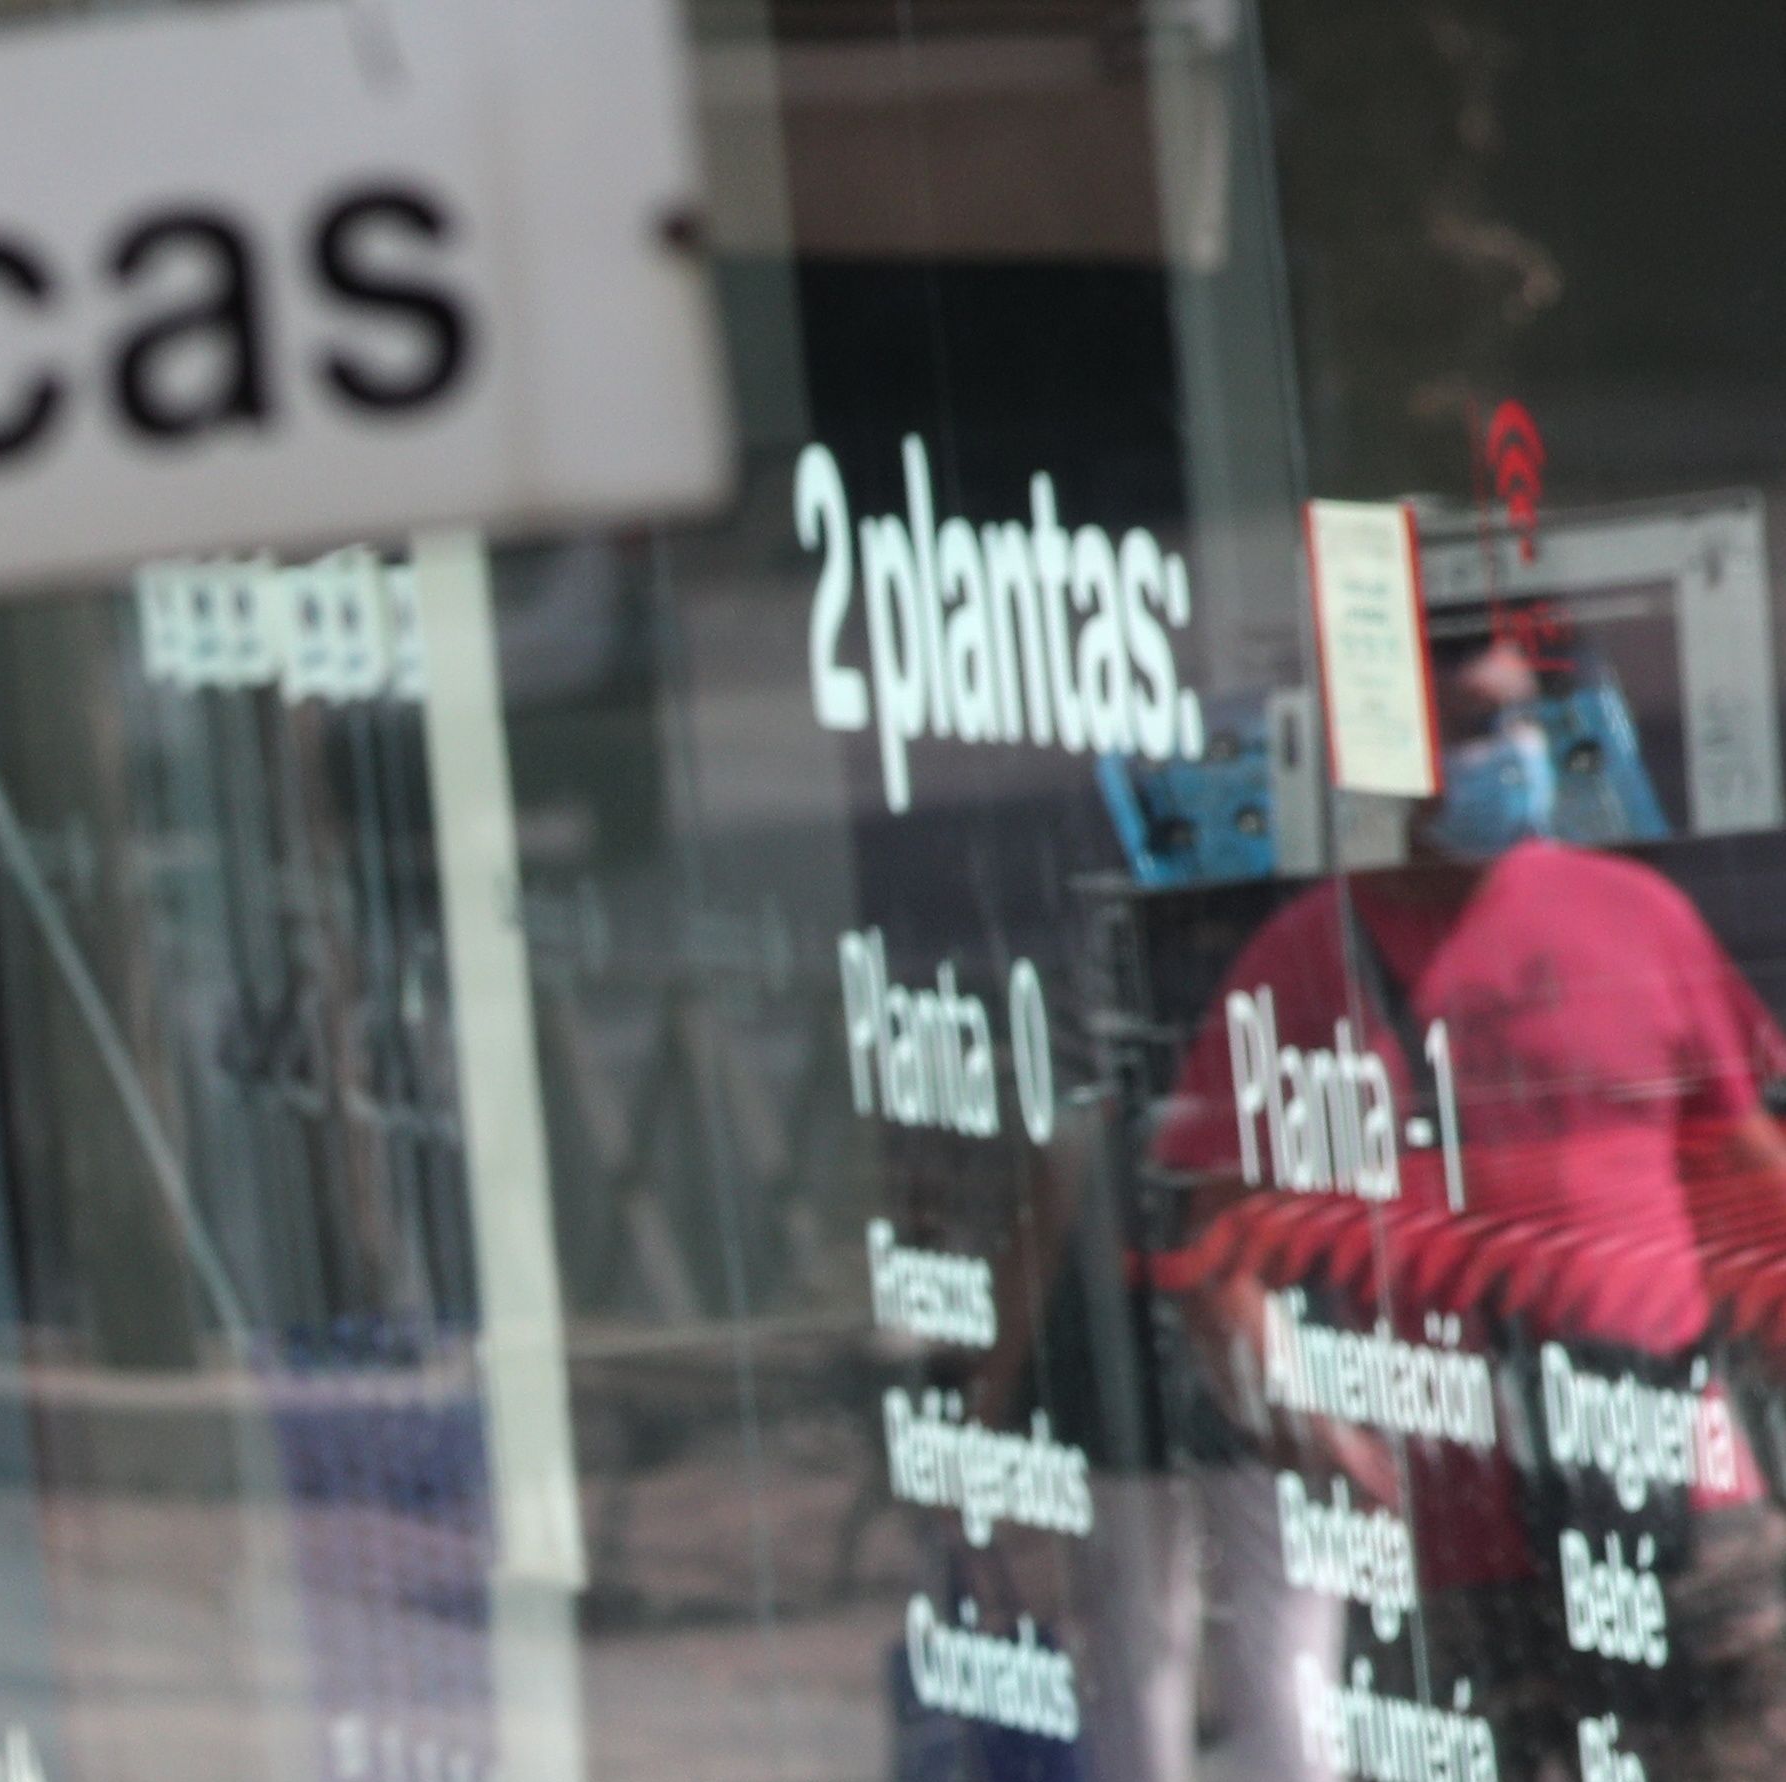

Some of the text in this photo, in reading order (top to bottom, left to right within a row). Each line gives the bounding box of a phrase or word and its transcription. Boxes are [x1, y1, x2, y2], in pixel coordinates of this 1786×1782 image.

[794, 442, 869, 731] 2
[858, 431, 1204, 816] plantas:
[838, 926, 1055, 1146] Planta 0
[1225, 984, 1465, 1212] Planta -1
[1265, 1285, 1496, 1448] Alimentación
[1540, 1341, 1738, 1512] Droguería
[882, 1386, 1095, 1547] Refrigerados
[1276, 1469, 1418, 1642] Bodega
[1559, 1528, 1668, 1670] Bebé
[905, 1593, 1080, 1744] Cocinados
